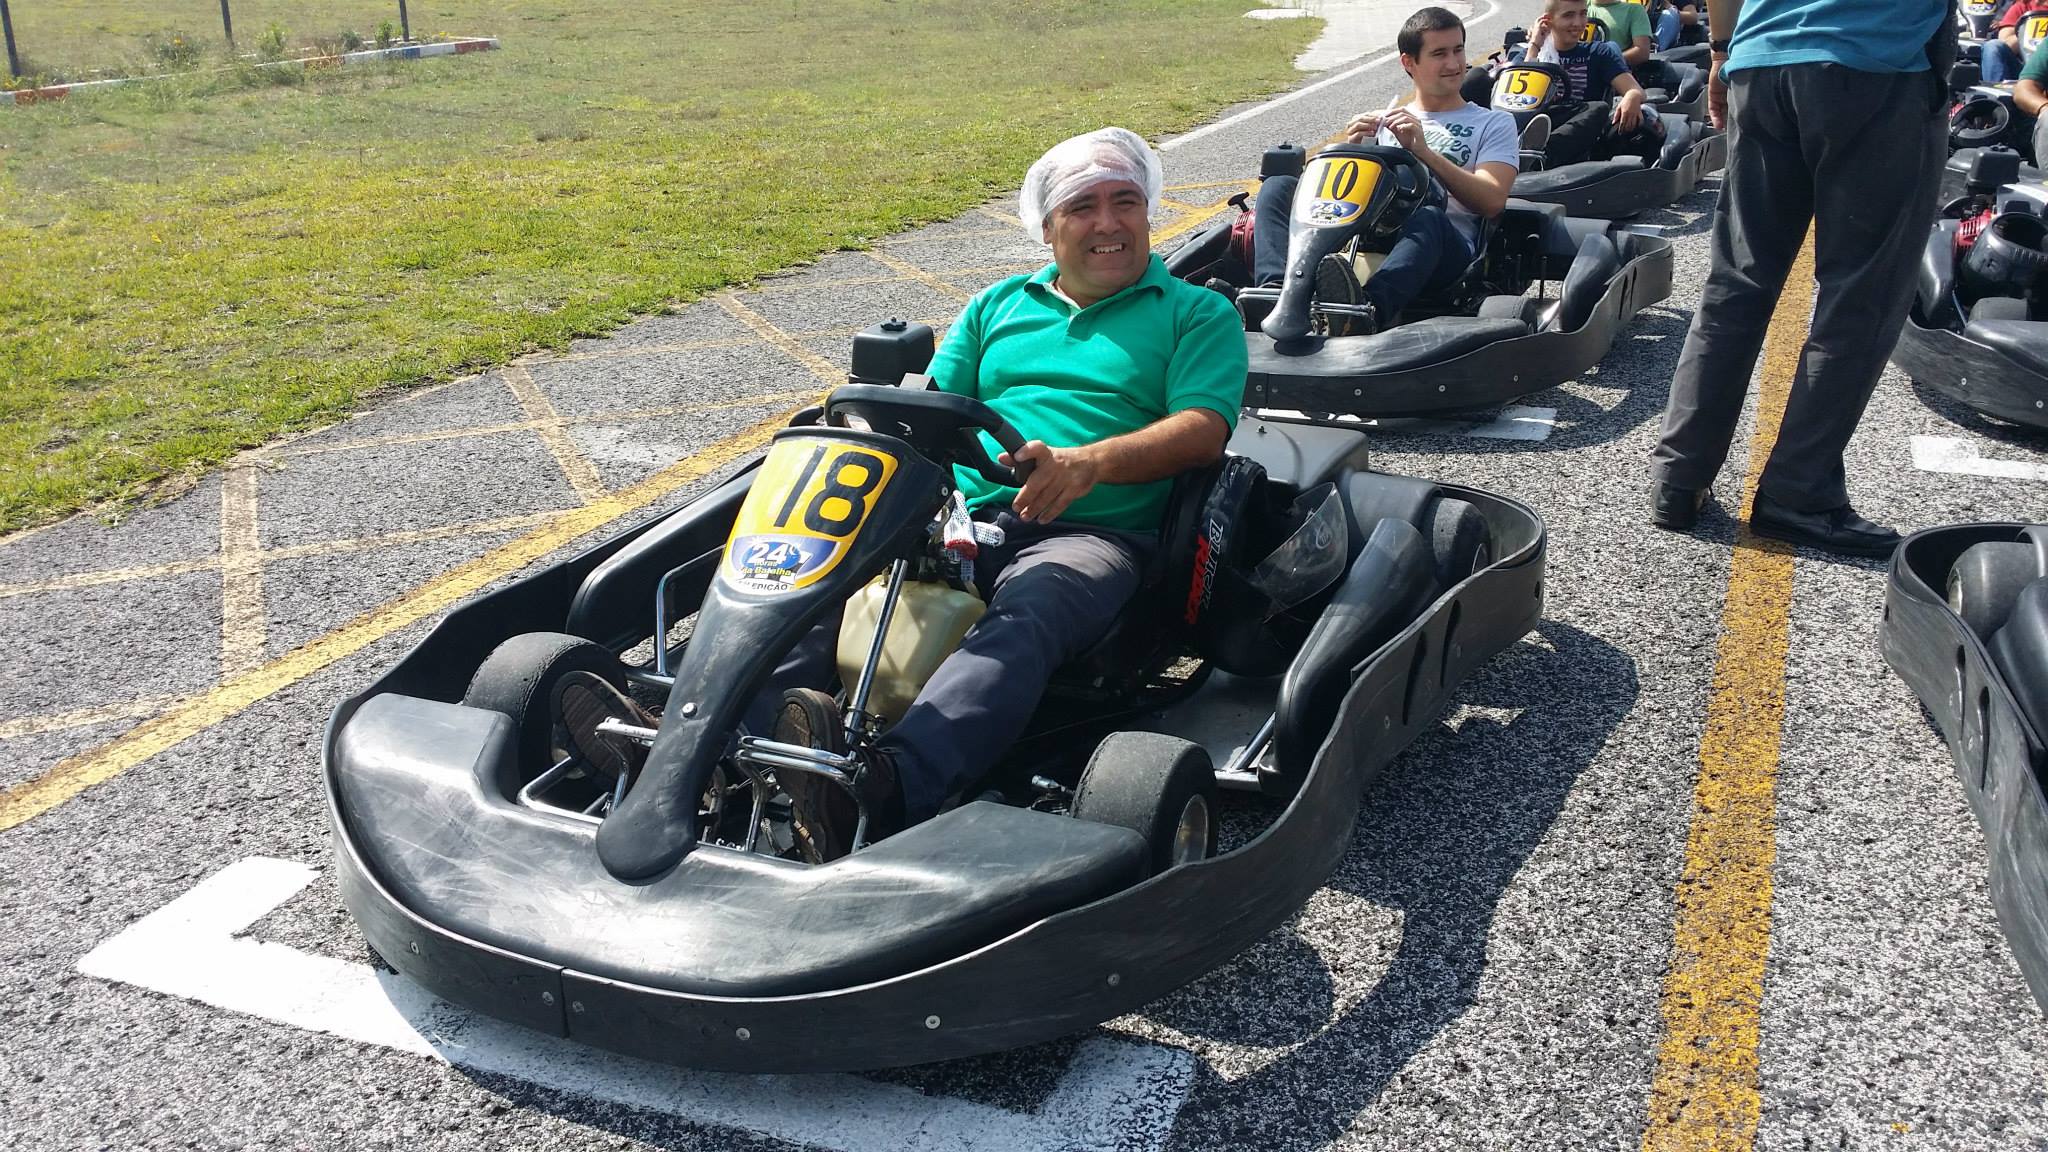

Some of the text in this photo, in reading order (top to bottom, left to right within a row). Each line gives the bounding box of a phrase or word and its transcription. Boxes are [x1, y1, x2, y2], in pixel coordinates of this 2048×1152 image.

[1504, 72, 1530, 94] 15
[1315, 160, 1358, 200] 10
[773, 445, 884, 537] 18
[746, 542, 788, 564] 24
